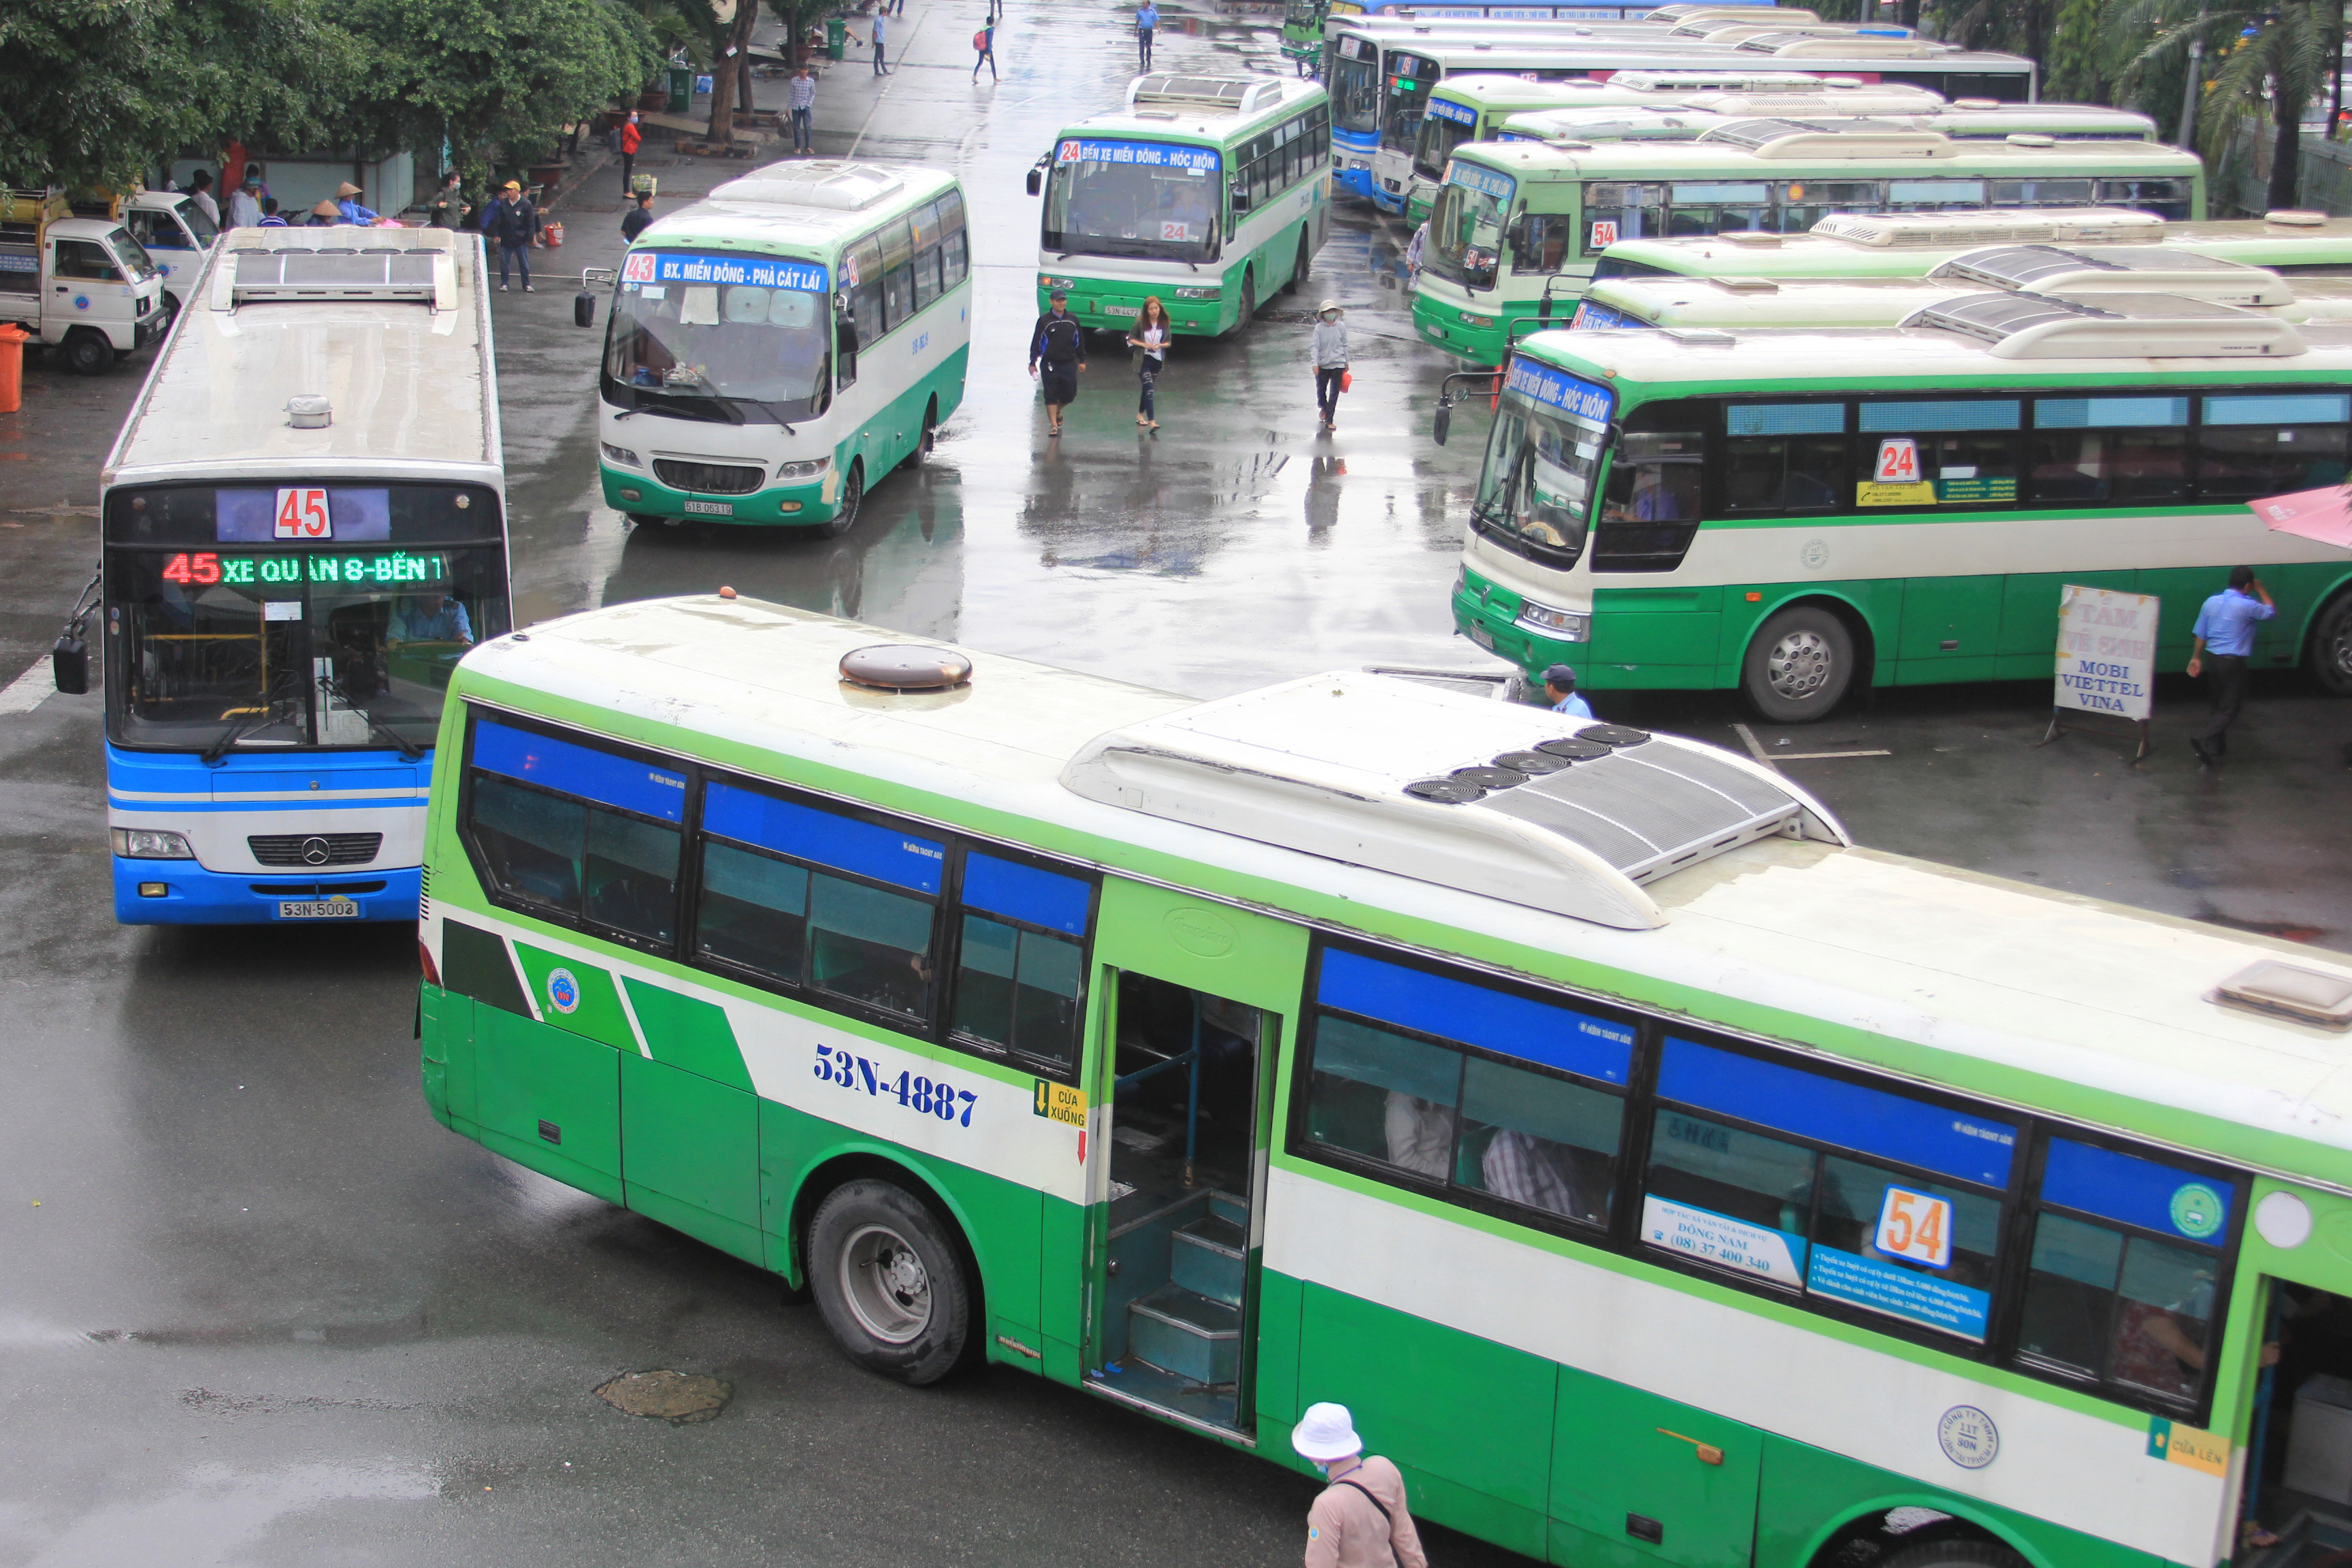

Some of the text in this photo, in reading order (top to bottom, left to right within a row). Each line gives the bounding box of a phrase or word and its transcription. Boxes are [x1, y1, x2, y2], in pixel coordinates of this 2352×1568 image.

[1062, 143, 1079, 161] 24
[1082, 143, 1099, 161] BẾN
[1100, 148, 1111, 162] XE
[1136, 148, 1161, 165] ĐÔNG
[1169, 150, 1191, 167] HÓC
[1192, 152, 1215, 170] MÔN
[1164, 225, 1185, 240] 24
[1595, 224, 1614, 246] 54
[849, 257, 858, 284] 43
[1465, 250, 1477, 268] 54
[625, 255, 654, 282] 43
[713, 262, 745, 284] ĐÔNG
[753, 265, 776, 286] PHÀ
[777, 261, 801, 289] CÁT
[802, 267, 821, 291] LÁI
[1539, 376, 1560, 403] ĐÔNG
[1561, 385, 1582, 412] HÓC
[1579, 393, 1609, 421] MÔN
[1881, 446, 1912, 476] 24
[279, 490, 326, 536] 45
[162, 553, 220, 584] 45
[223, 560, 255, 583] XE
[2078, 660, 2129, 679] MOBI
[2061, 674, 2144, 698] VIETTEL
[2078, 693, 2125, 712] VINA
[284, 903, 353, 916] 53N-5003
[814, 1043, 978, 1128] 53N-4887
[1058, 1089, 1078, 1107] CỬA
[1051, 1106, 1084, 1127] XUỐNG
[1678, 1222, 1748, 1250] ĐÔNG NAM
[1887, 1191, 1942, 1260] 54
[1671, 1233, 1769, 1272] (08) 37 400 340
[1960, 1422, 1978, 1434] 11T
[2172, 1438, 2223, 1465] CỬA LÊN
